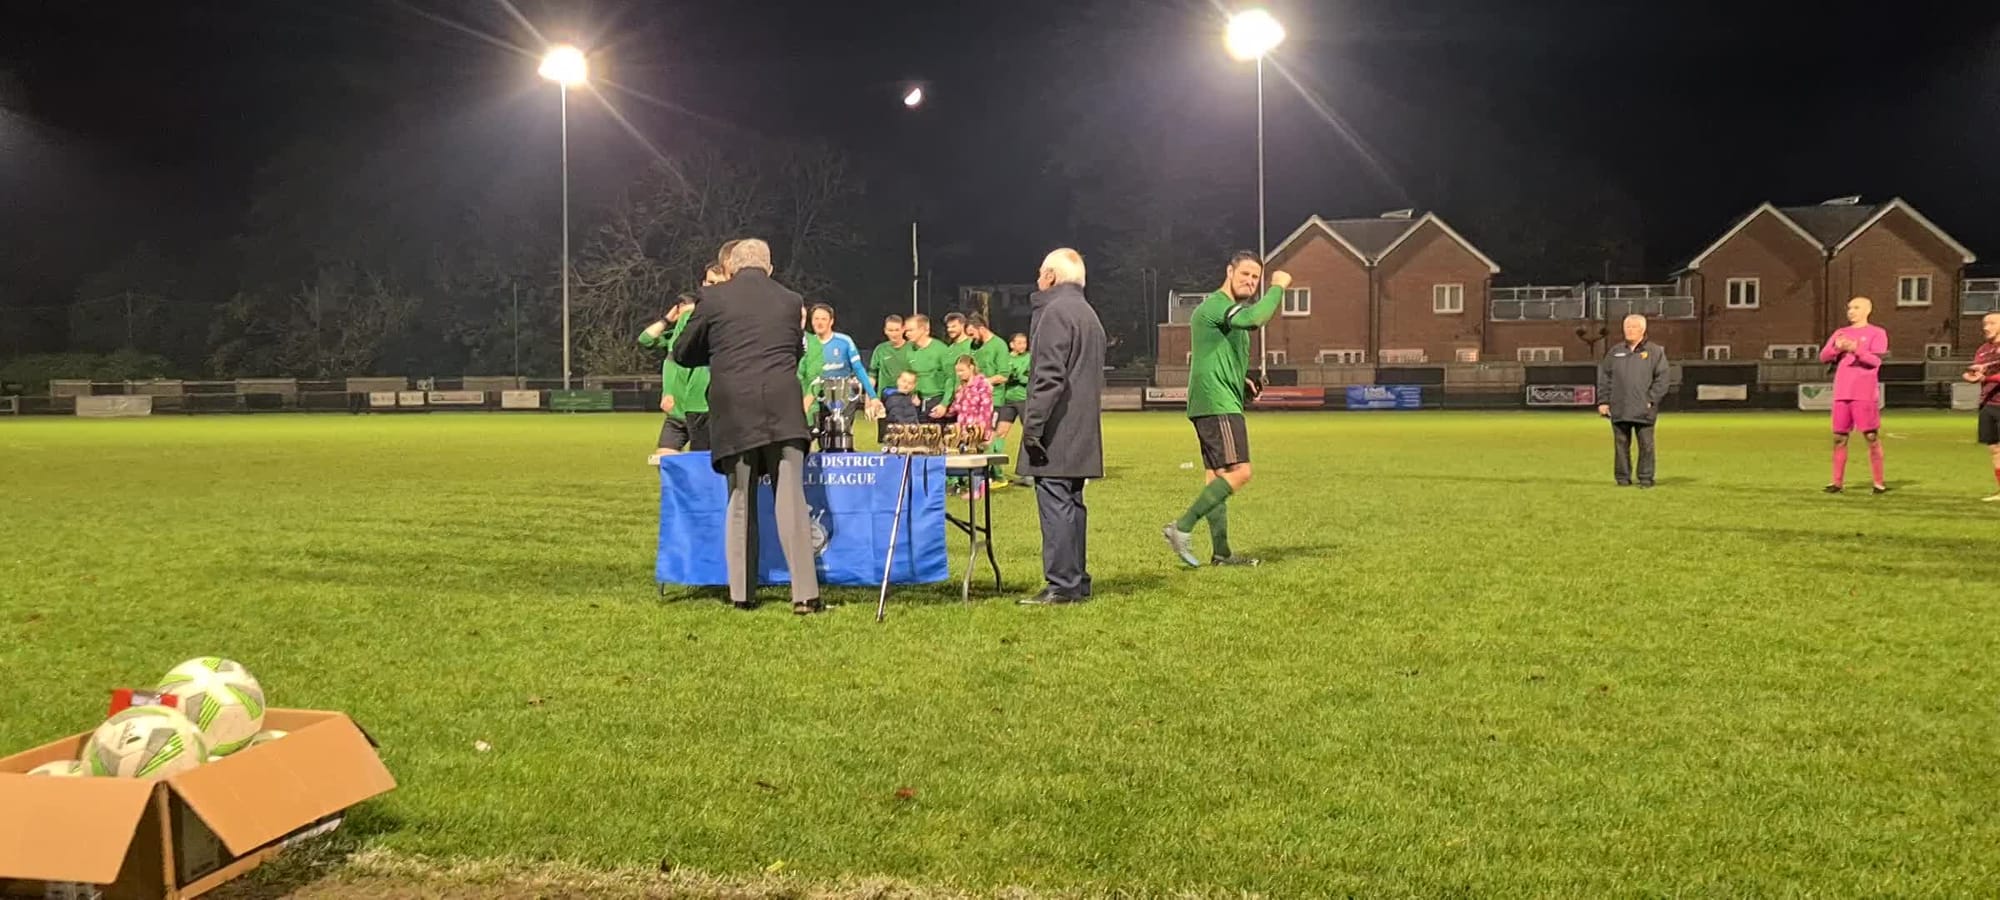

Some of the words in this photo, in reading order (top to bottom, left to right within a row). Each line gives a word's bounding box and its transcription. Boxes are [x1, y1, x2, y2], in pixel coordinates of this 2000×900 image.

[807, 456, 817, 468] &
[821, 455, 886, 467] DISTRICT
[820, 473, 876, 485] LEAGUE
